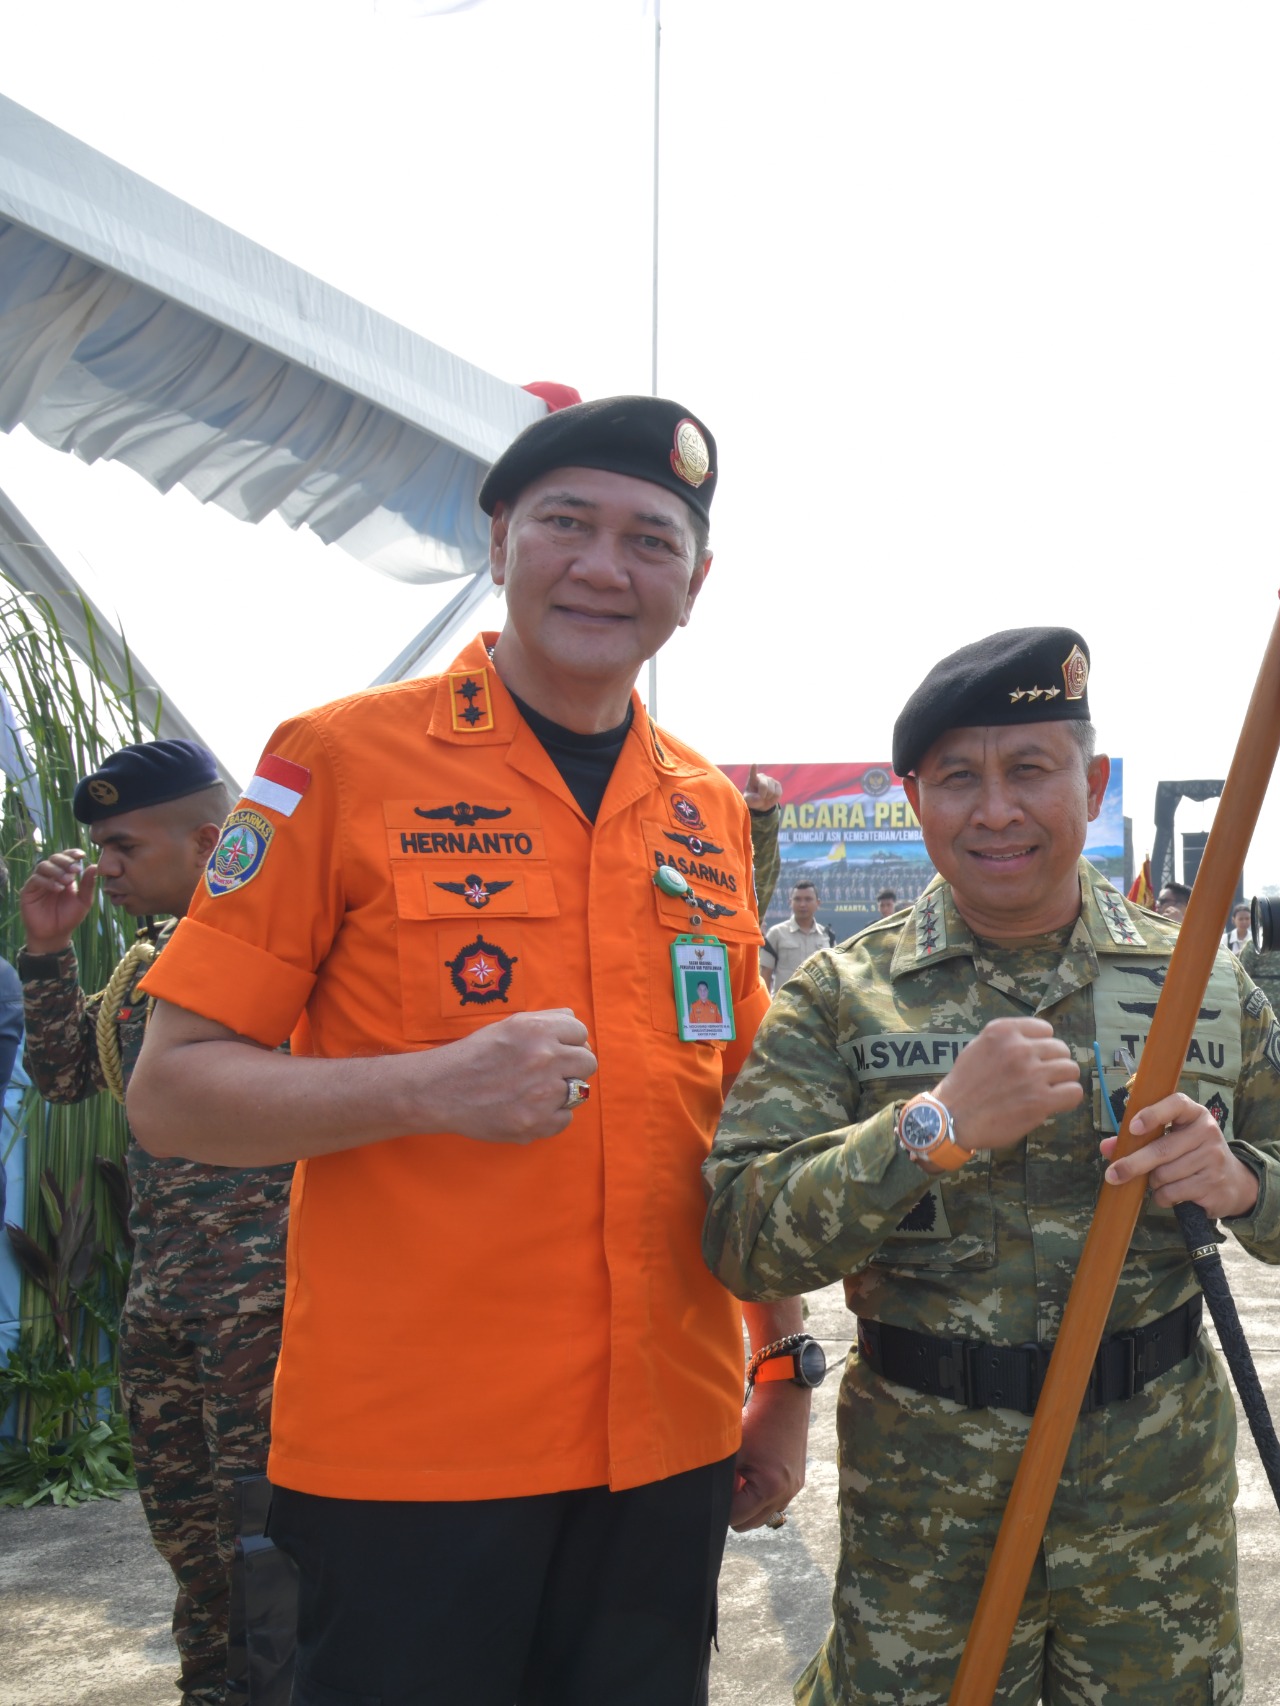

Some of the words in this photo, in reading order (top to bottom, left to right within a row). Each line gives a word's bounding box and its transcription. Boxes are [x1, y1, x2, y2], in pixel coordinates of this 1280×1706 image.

[229, 812, 271, 838] BASARNAS
[780, 802, 866, 829] ACARA
[874, 802, 920, 829] PEN
[400, 832, 533, 855] HERNANTO
[778, 831, 791, 842] MIL
[843, 830, 923, 842] KEMENTERIAN/LEMBA
[654, 850, 737, 893] BASARNAS
[834, 904, 869, 913] JAKARTA,
[852, 1040, 969, 1072] M.SYAFI
